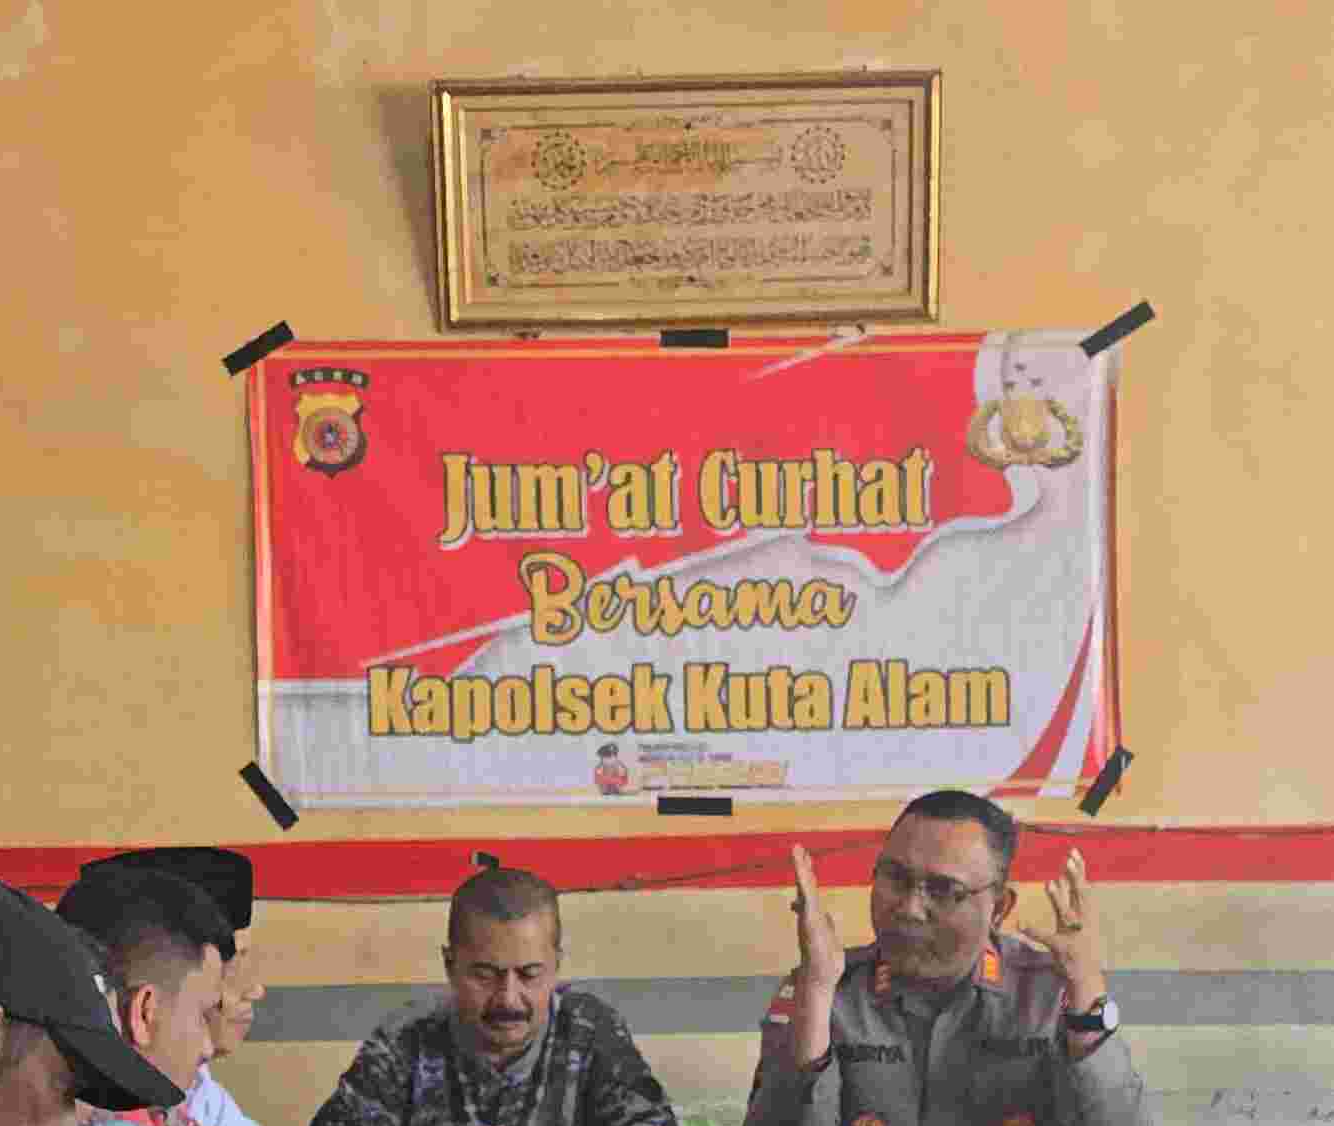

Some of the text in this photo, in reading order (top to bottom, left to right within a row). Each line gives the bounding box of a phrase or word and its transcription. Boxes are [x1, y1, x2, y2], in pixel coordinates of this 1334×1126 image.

[437, 446, 932, 546] Jum'at Curhat
[518, 550, 857, 646] Bersama
[367, 657, 1011, 744] Kapolsek Kuta Alam
